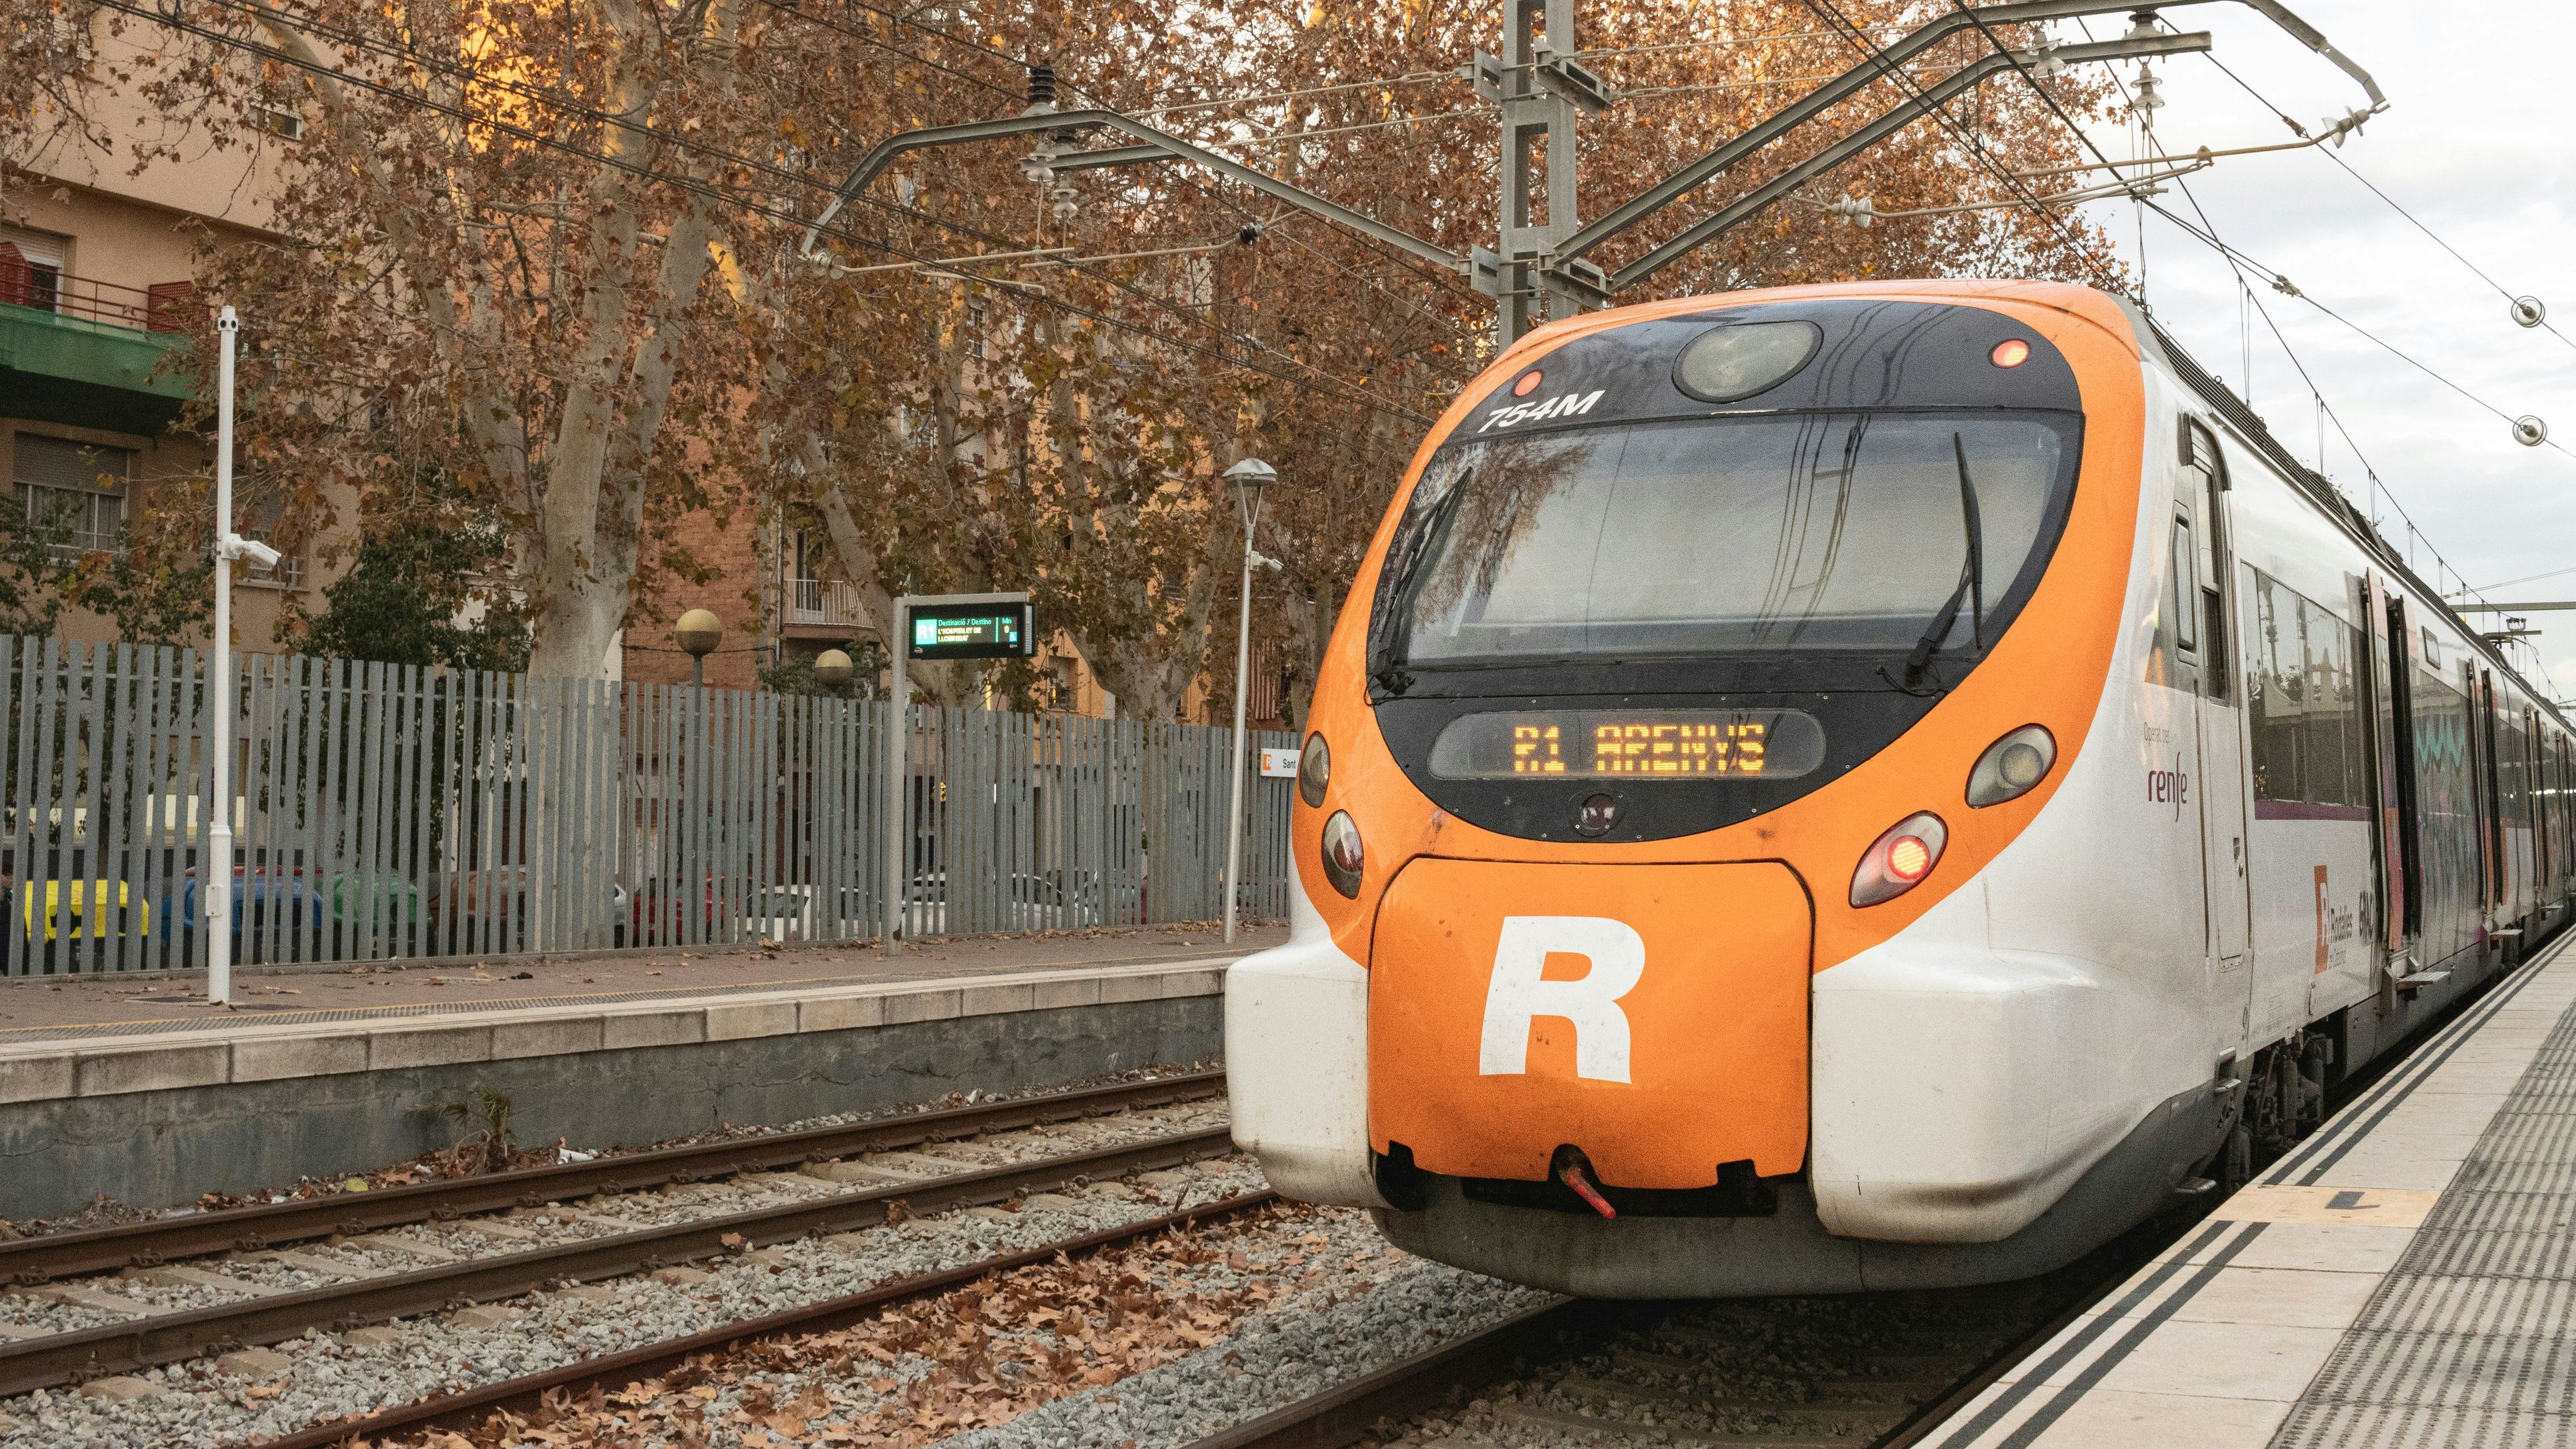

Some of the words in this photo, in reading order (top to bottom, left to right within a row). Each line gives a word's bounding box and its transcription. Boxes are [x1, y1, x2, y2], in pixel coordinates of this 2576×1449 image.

[1477, 390, 1605, 433] 754M
[917, 624, 935, 640] R1
[938, 618, 965, 626] Destinació
[1283, 759, 1296, 768] Sant
[1515, 726, 1565, 772] R1
[1597, 724, 1764, 772] ARENYS
[2148, 752, 2187, 822] renfe
[1479, 916, 1645, 1084] R
